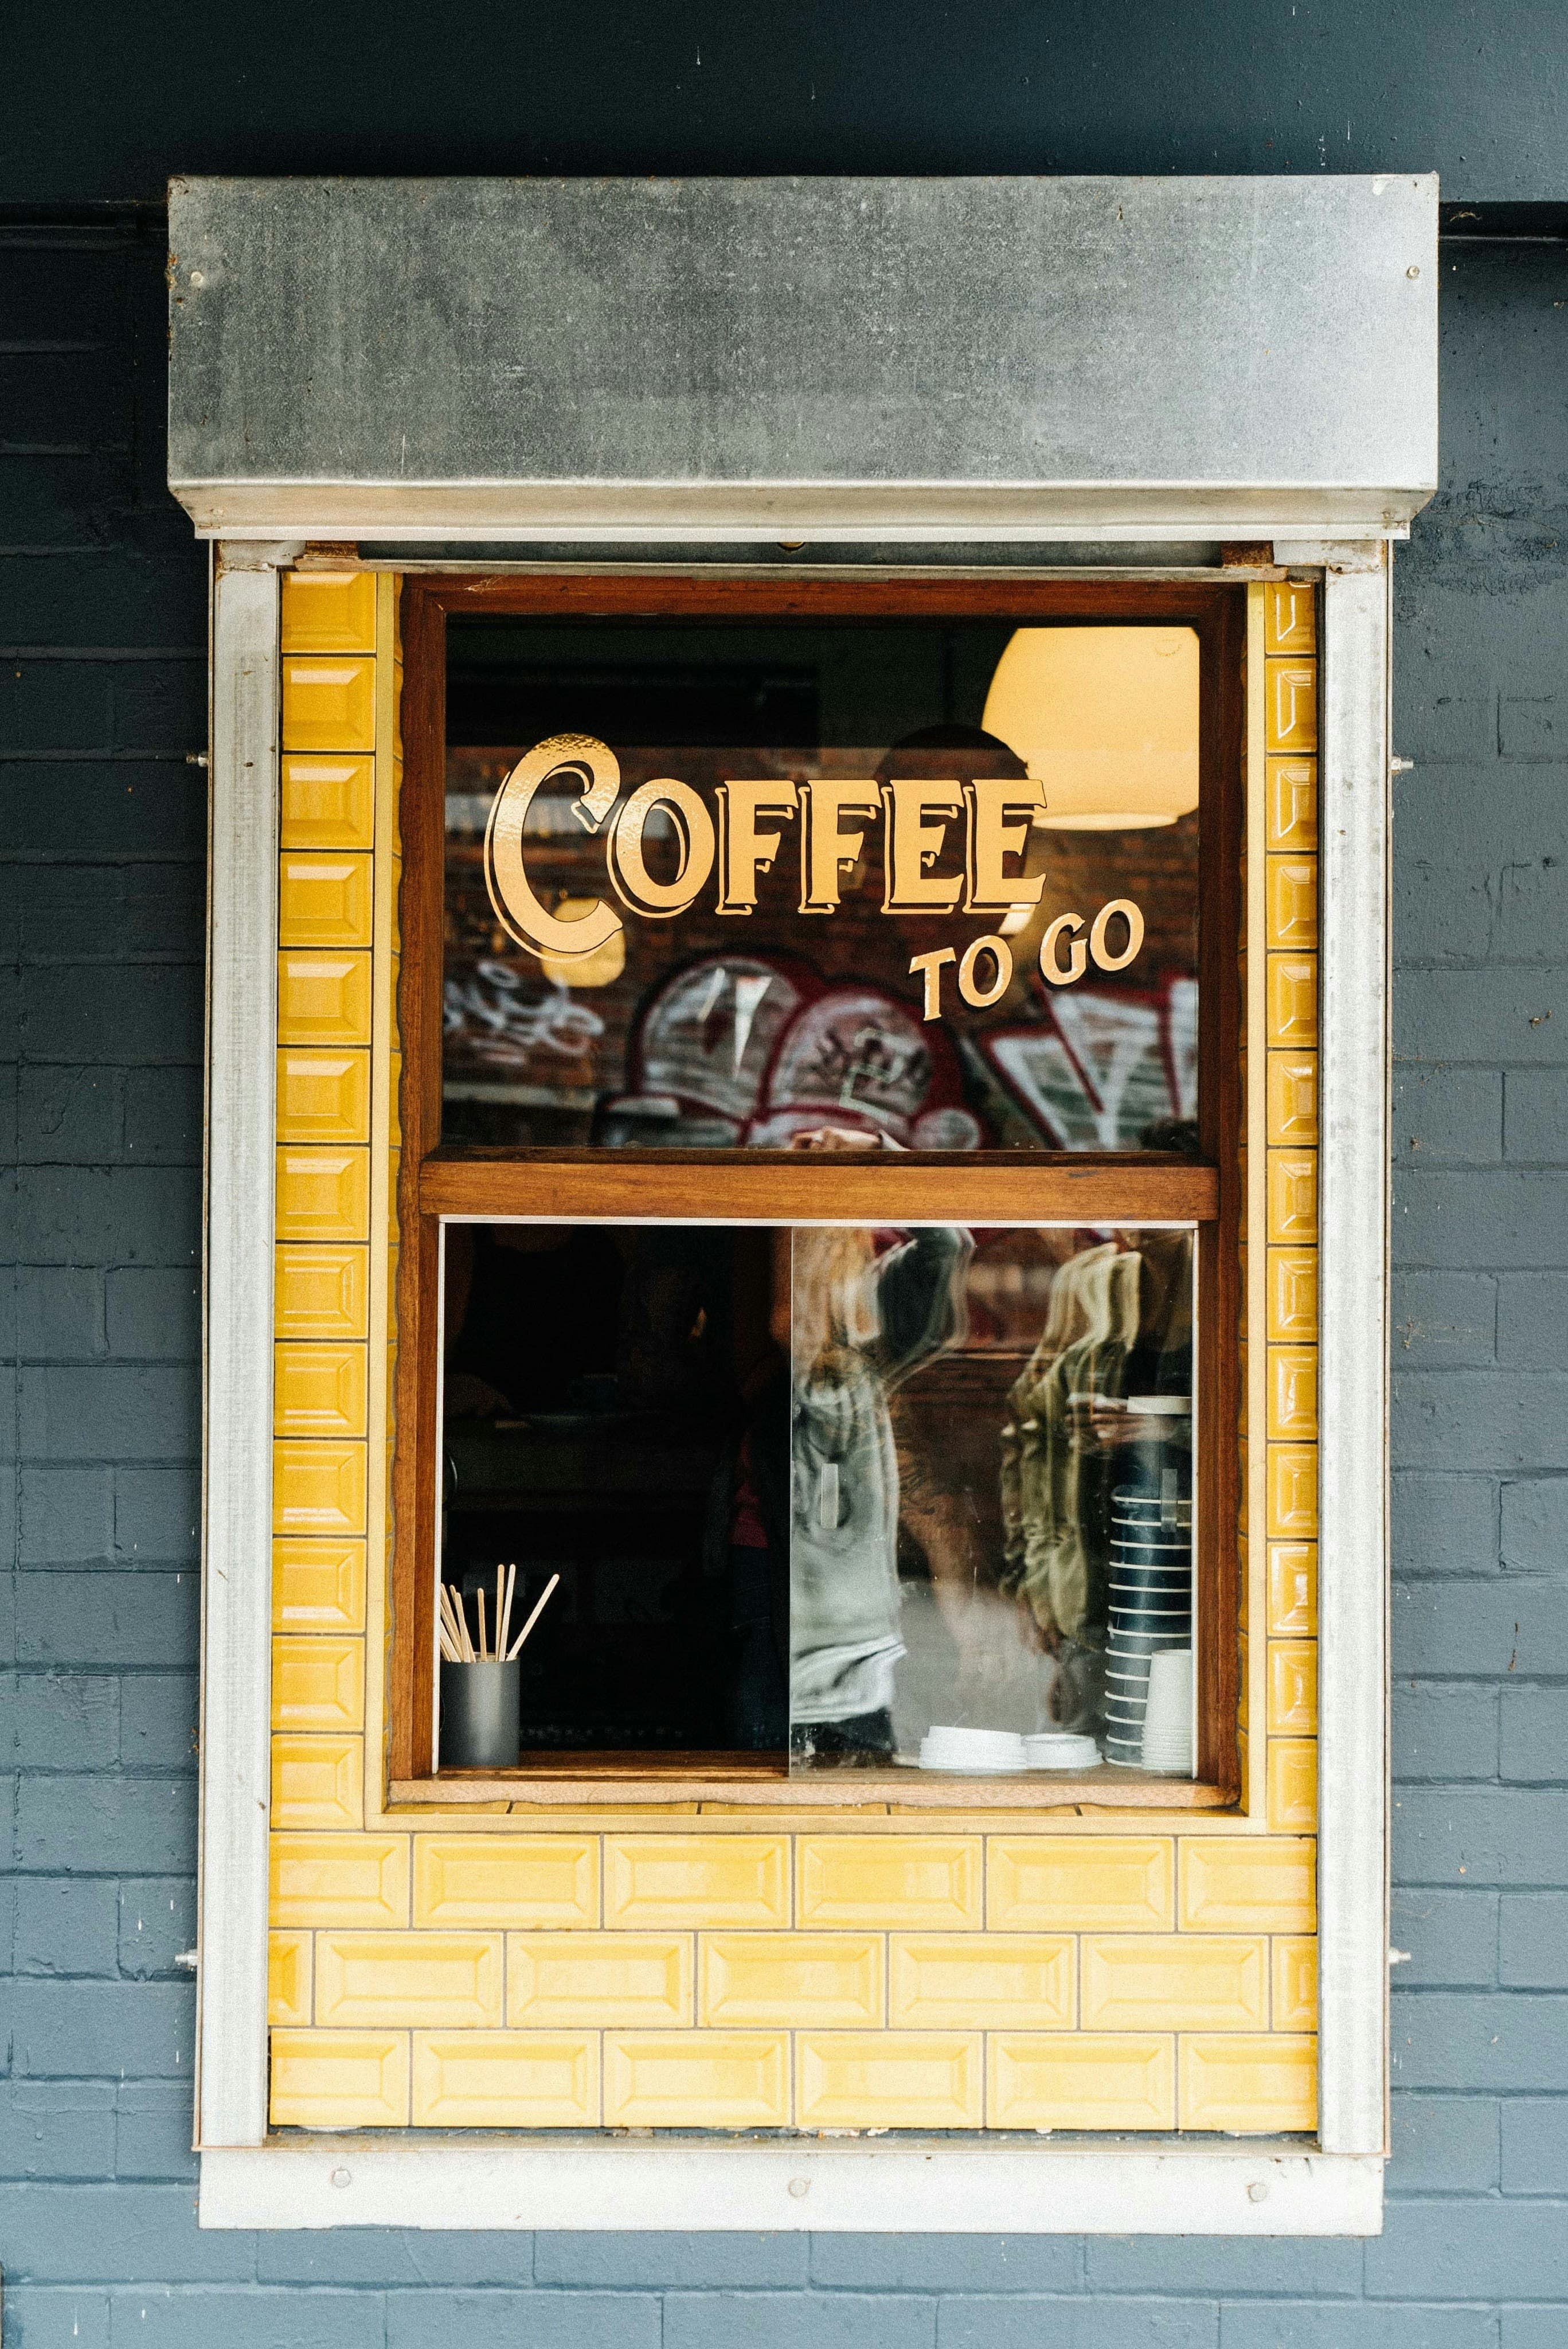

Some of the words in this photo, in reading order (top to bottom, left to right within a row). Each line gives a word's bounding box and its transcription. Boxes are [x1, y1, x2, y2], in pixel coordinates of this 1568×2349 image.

[484, 733, 1047, 963] COFFEE
[909, 935, 1013, 1021] TO
[1040, 899, 1144, 986] GO
